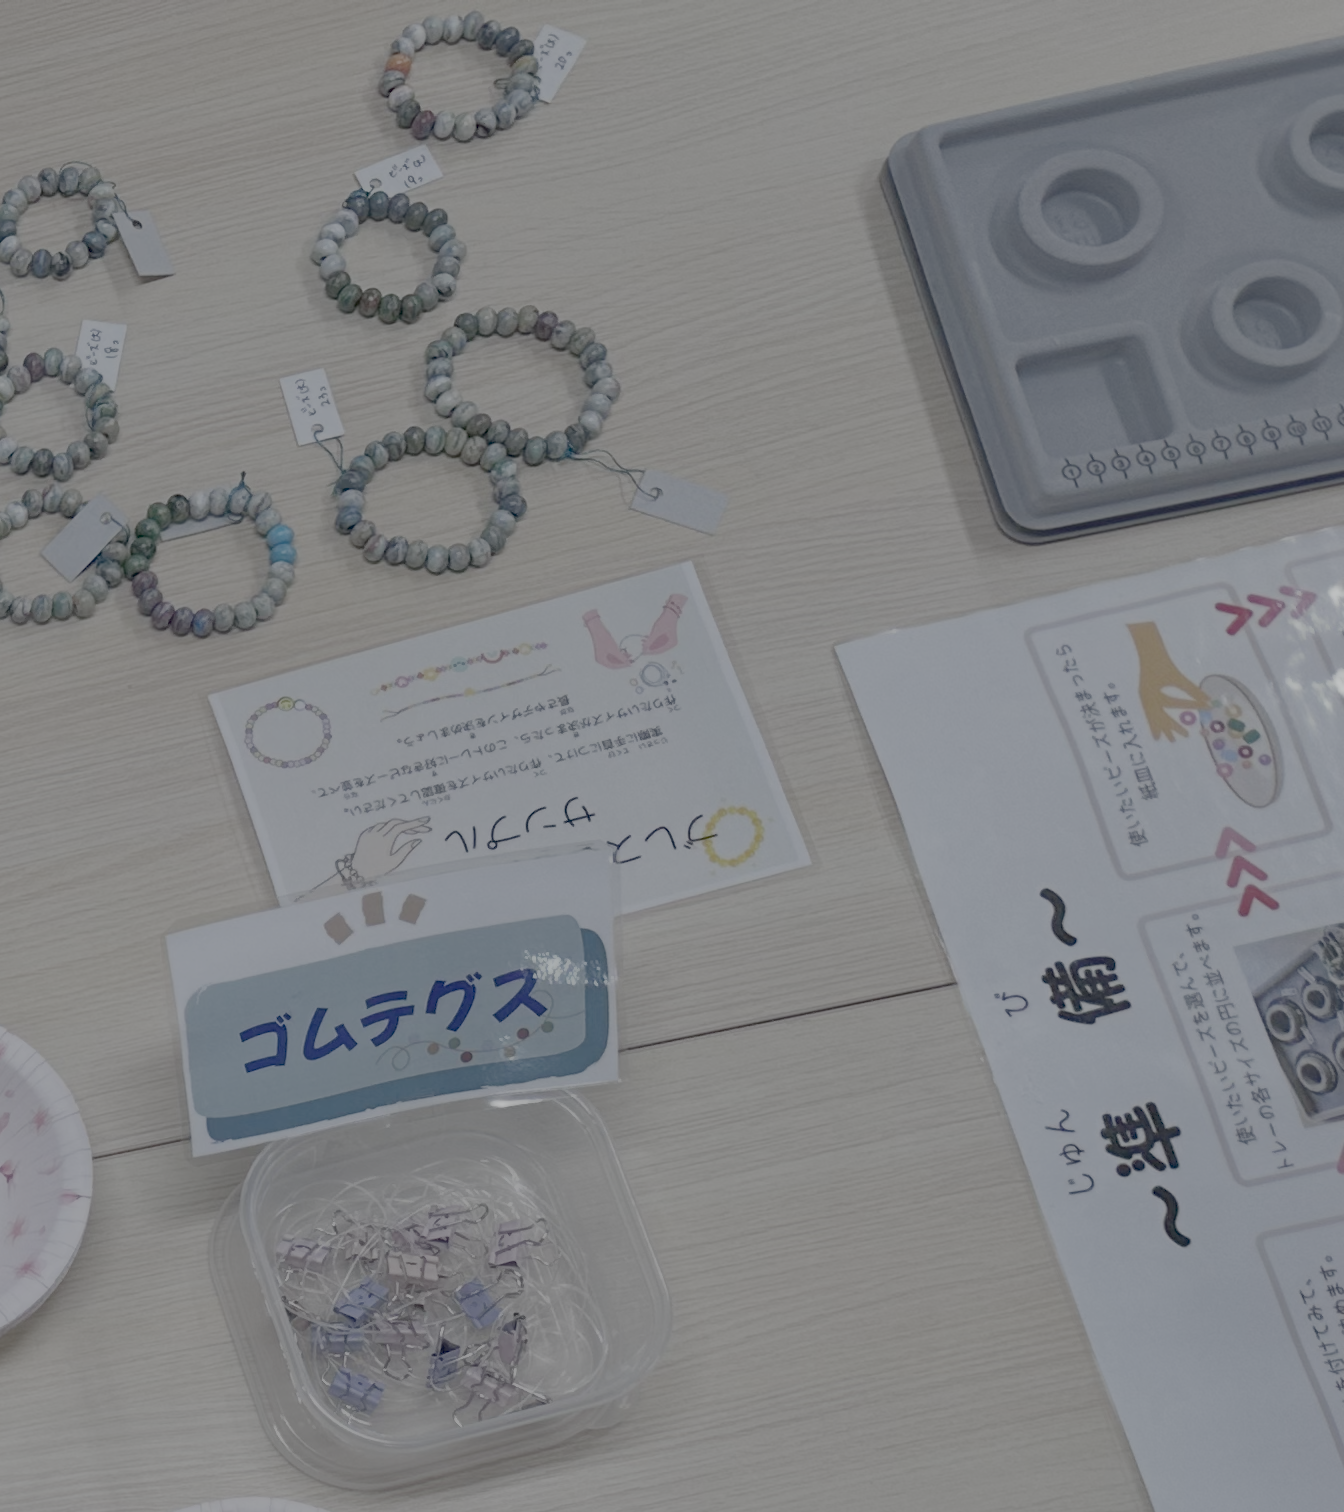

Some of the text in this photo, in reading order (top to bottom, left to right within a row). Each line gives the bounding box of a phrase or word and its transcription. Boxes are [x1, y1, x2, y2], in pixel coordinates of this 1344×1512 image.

[397, 695, 571, 746] 長さやデザインを決めましょう。
[1056, 644, 1148, 848] 使いたいビーズが決まったら
[1104, 682, 1159, 800] 紙皿に入れます。
[445, 797, 595, 852] サンプル
[239, 968, 548, 1073] ゴムテグス
[994, 991, 1094, 1195] じゅん び
[1171, 952, 1257, 1145] 使いたいビーズを選んで、
[1186, 913, 1294, 1170] トレーの各サイズの円に並べます。
